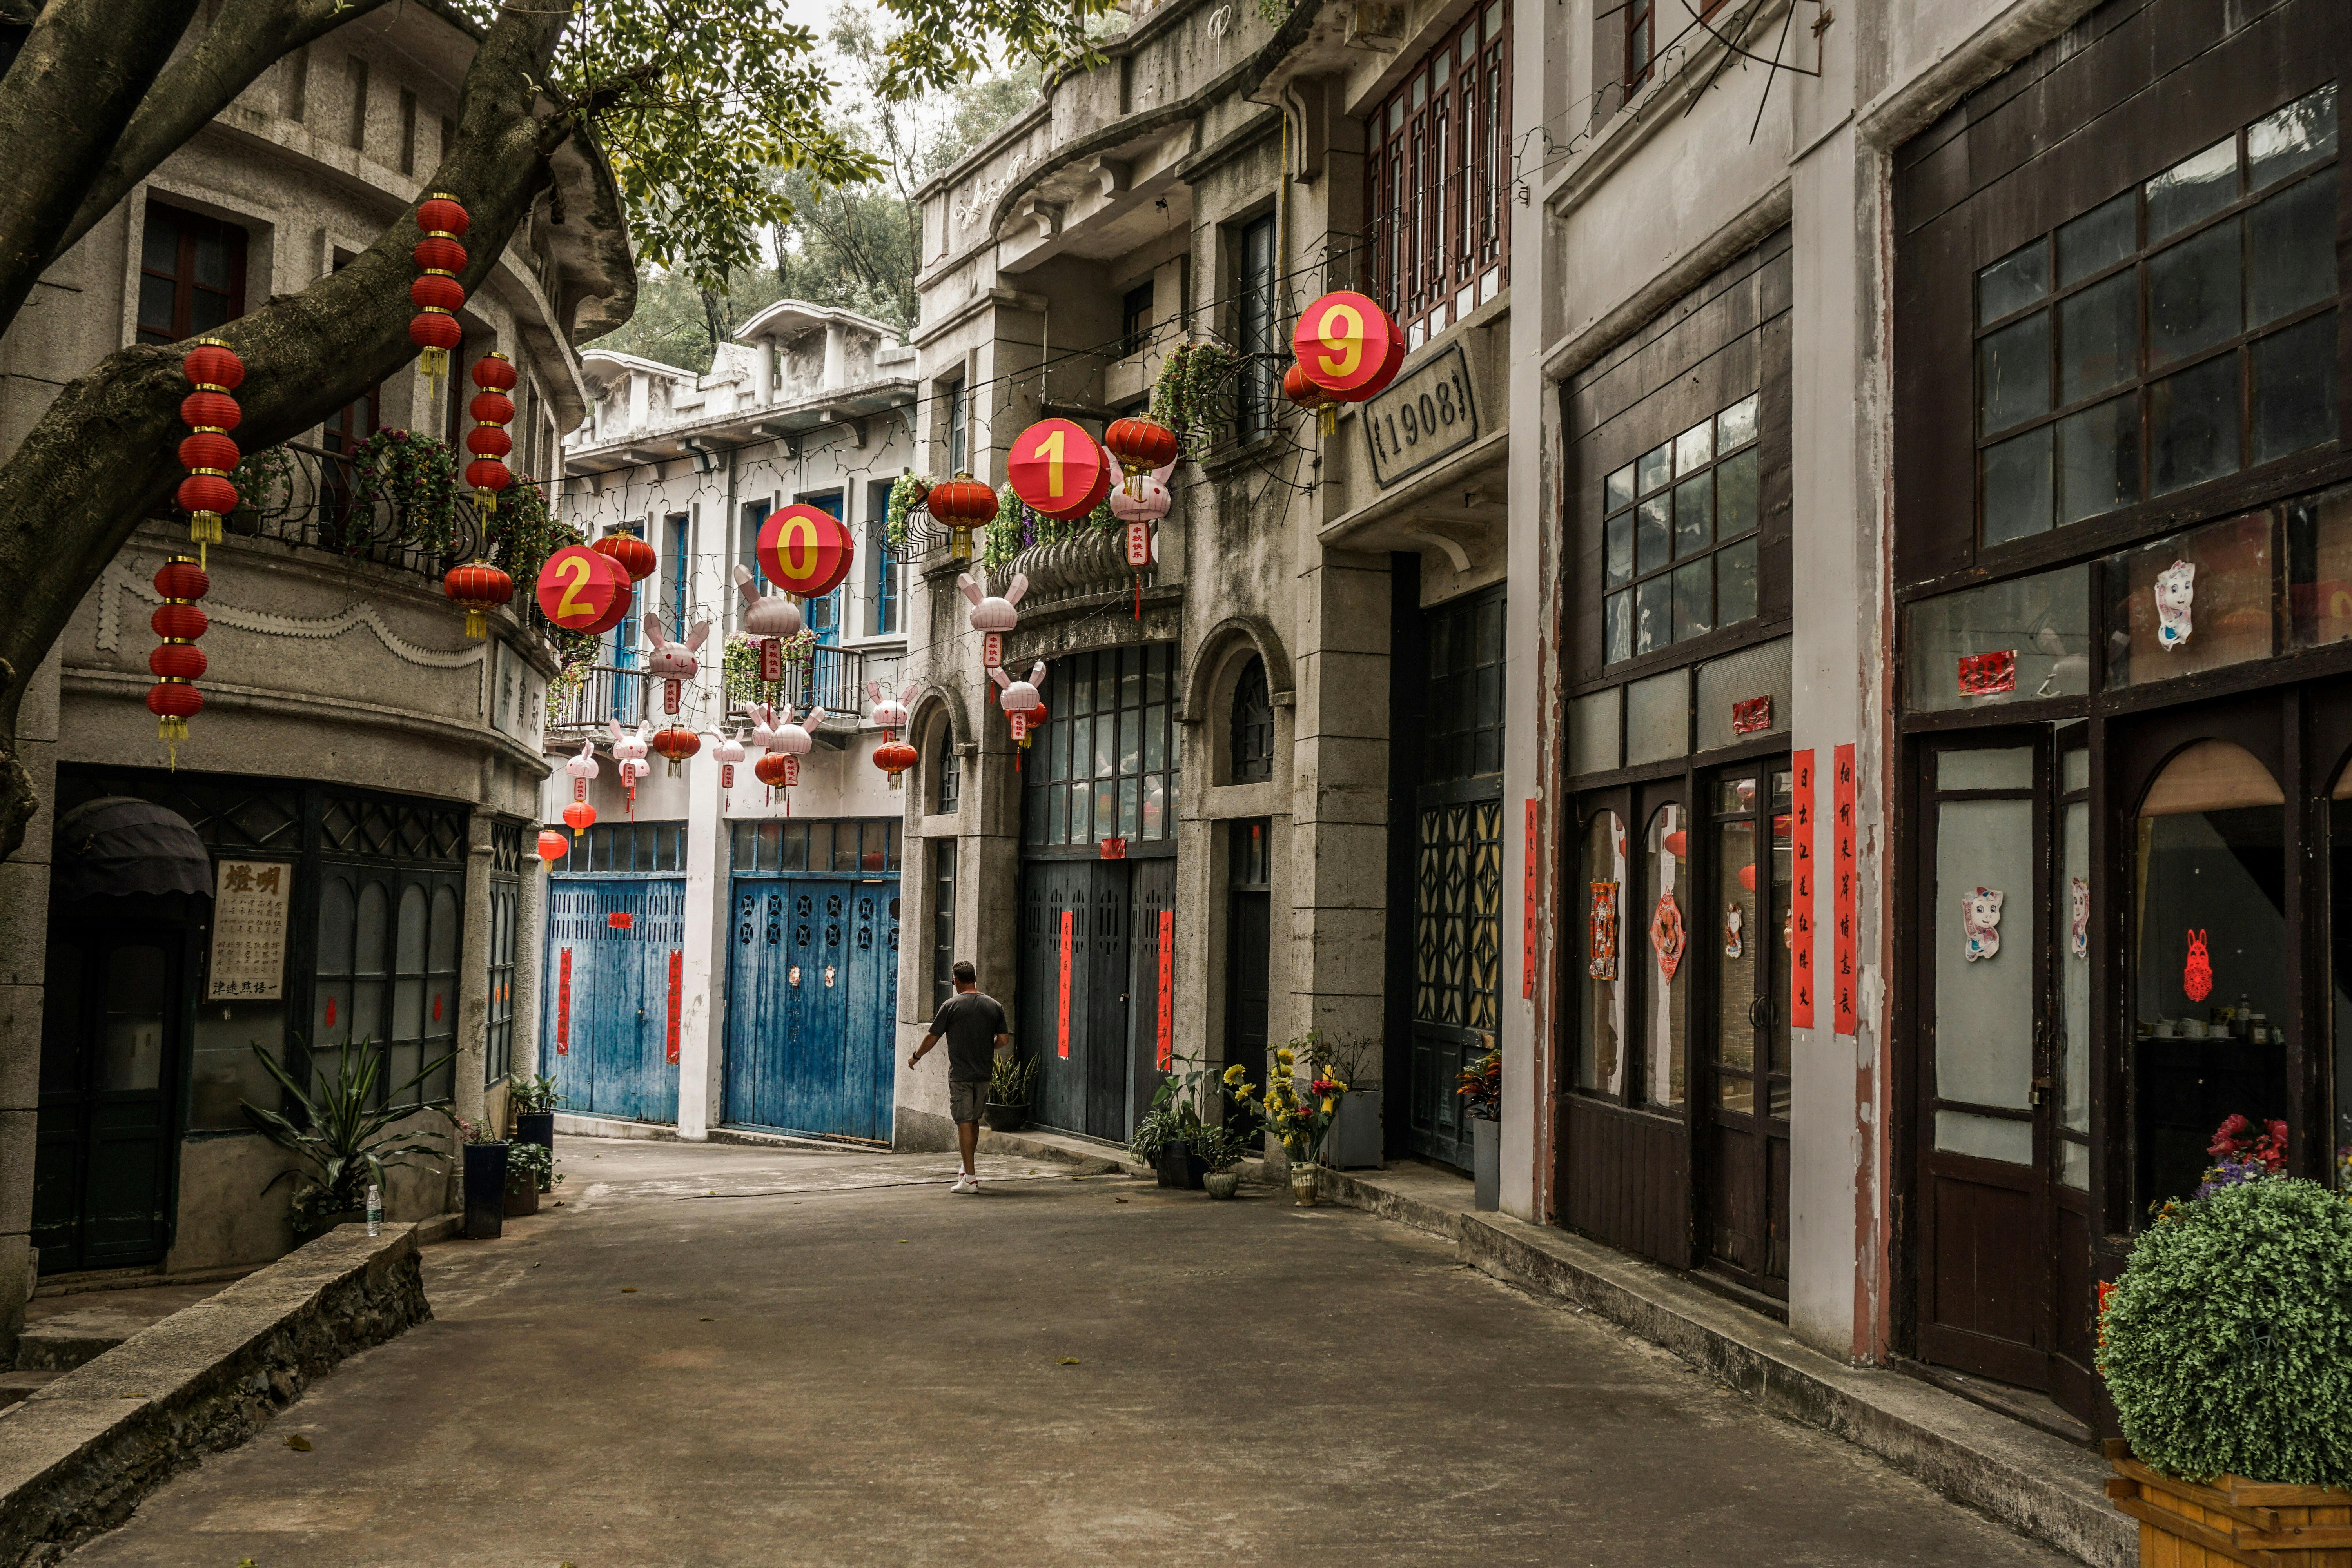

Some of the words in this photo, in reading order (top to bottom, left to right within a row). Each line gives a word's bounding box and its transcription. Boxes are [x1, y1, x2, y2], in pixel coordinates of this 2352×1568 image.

[1318, 304, 1364, 377] 9
[1385, 381, 1455, 454] 1908
[1034, 430, 1064, 497] 1
[777, 516, 818, 579] 0
[1132, 527, 1143, 558] 中秋快乐
[555, 556, 595, 619] 2
[769, 644, 778, 674] 中秋快乐
[988, 637, 998, 662] 中秋快乐
[1015, 715, 1024, 737] 中秋快乐
